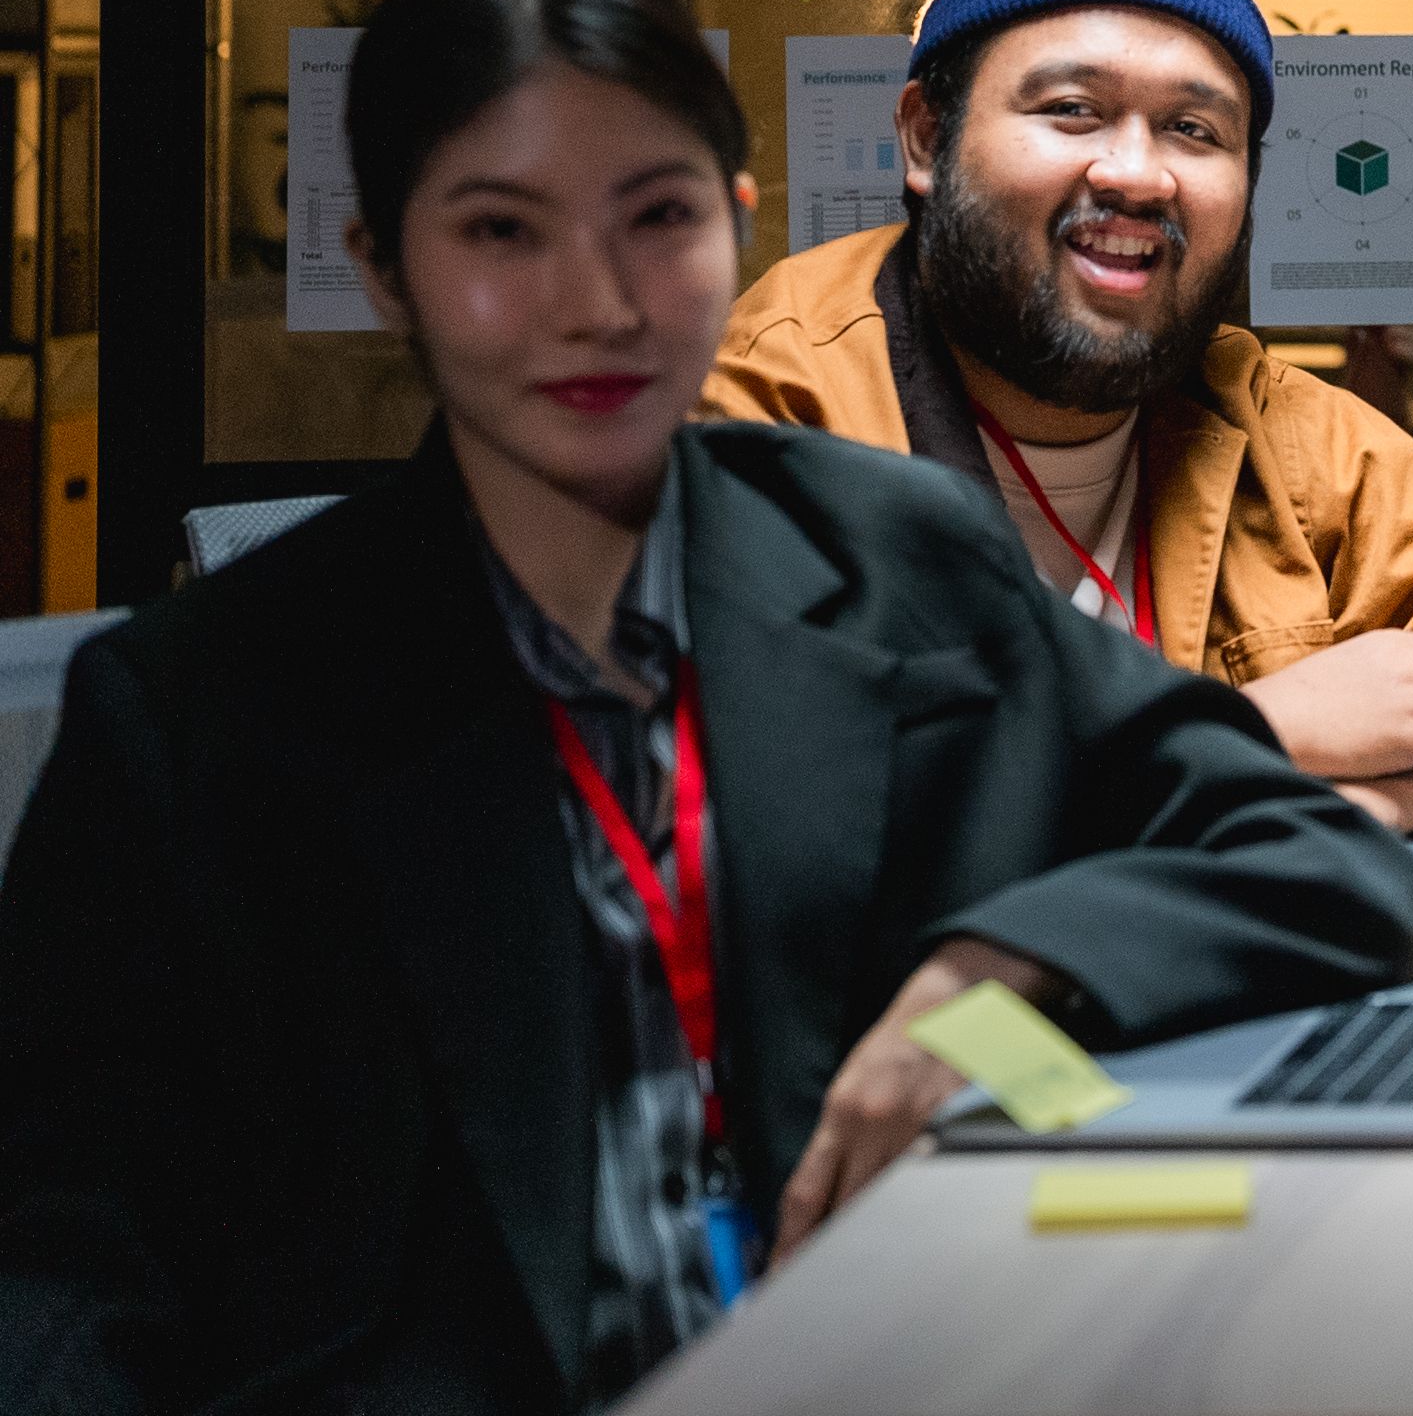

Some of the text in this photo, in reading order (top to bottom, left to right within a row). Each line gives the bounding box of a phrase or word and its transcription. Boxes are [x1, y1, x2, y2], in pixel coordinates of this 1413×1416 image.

[1273, 59, 1386, 77] Environment
[803, 71, 887, 85] Performance
[1354, 88, 1369, 99] 01
[1355, 239, 1371, 251] 04
